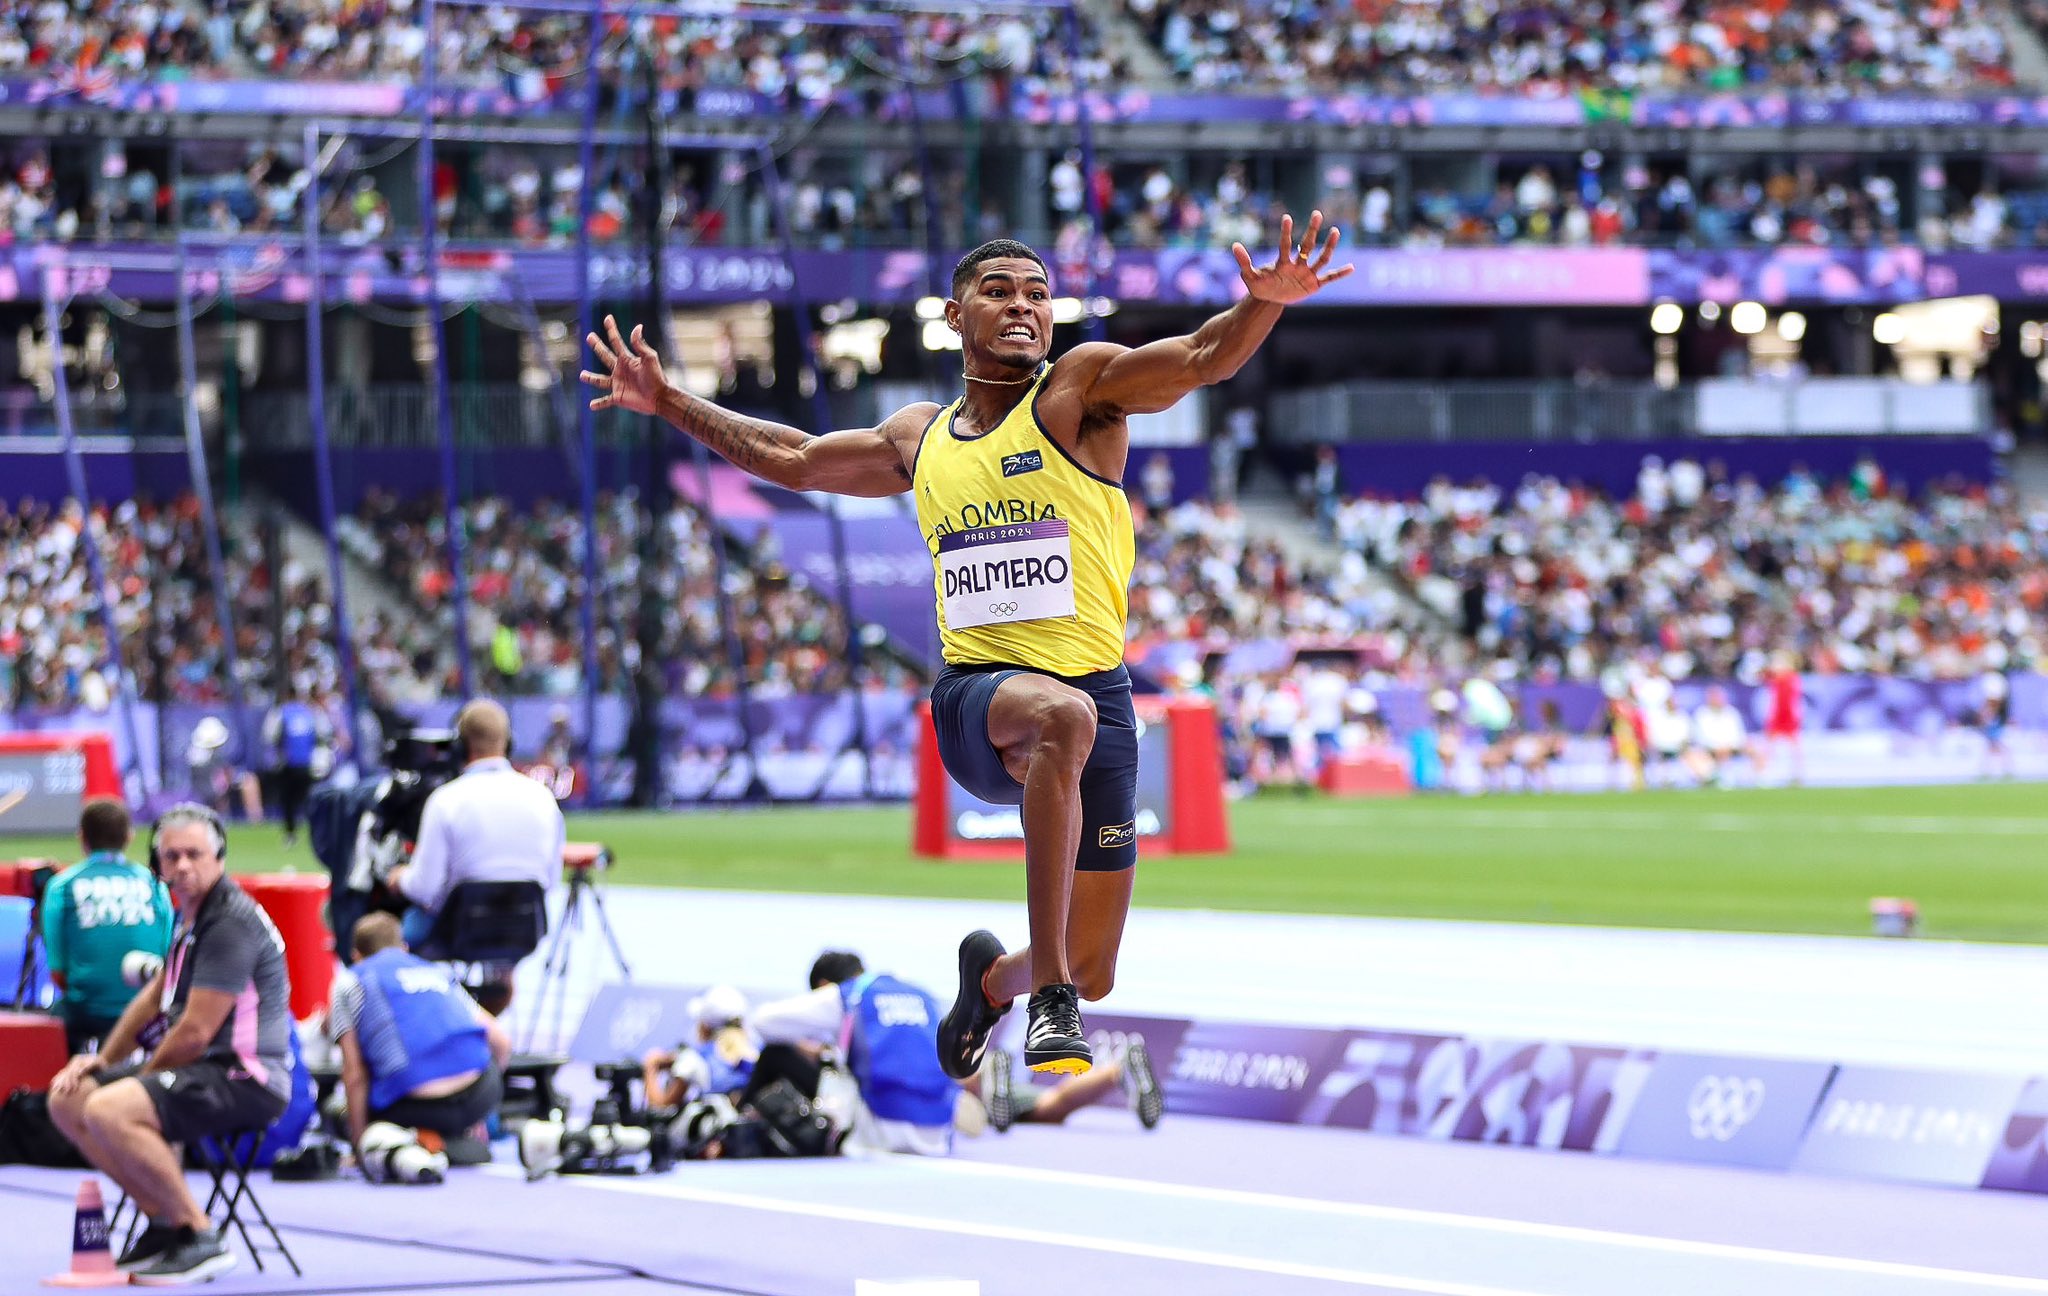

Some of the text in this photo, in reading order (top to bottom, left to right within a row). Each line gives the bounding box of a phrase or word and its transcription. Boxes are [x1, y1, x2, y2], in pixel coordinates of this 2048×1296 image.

[1021, 455, 1041, 466] FCA
[964, 527, 1032, 543] PARIS 2024
[945, 554, 1069, 599] DALMERO
[72, 875, 152, 903] PARIS
